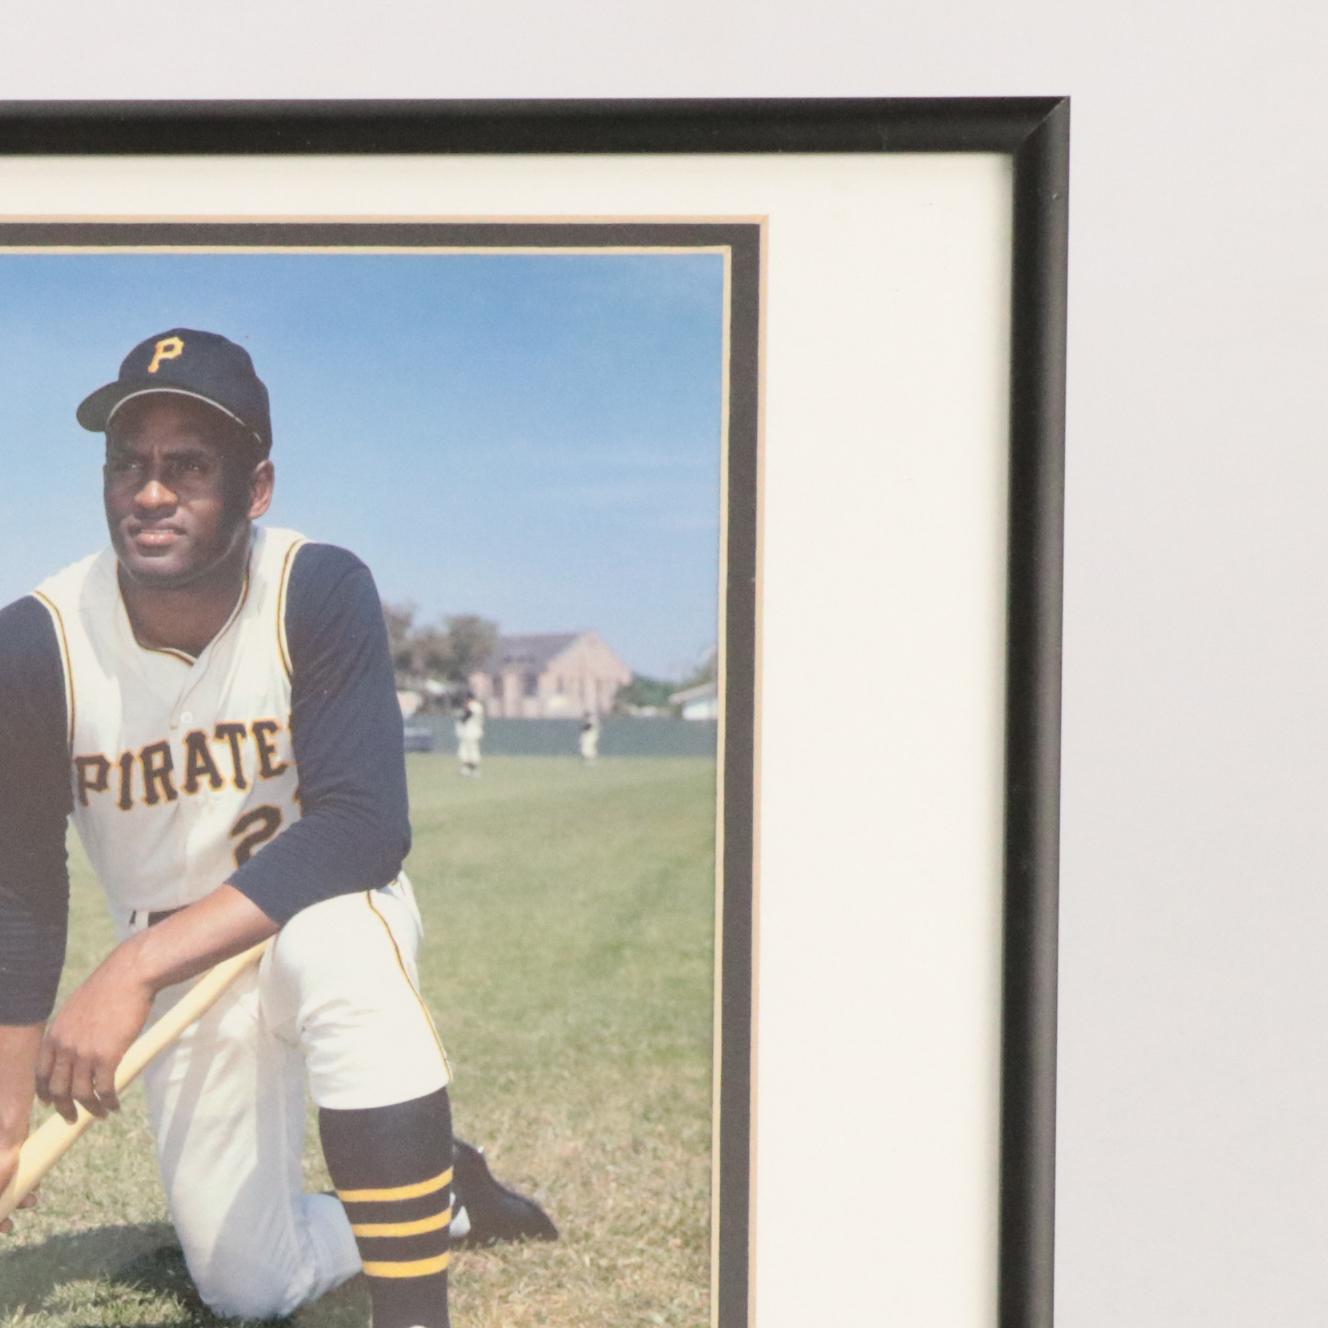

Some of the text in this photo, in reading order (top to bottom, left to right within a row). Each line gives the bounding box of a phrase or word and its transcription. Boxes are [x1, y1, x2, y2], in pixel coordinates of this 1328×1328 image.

[147, 336, 185, 374] P
[74, 719, 296, 811] PIRATE
[230, 804, 284, 869] 2
